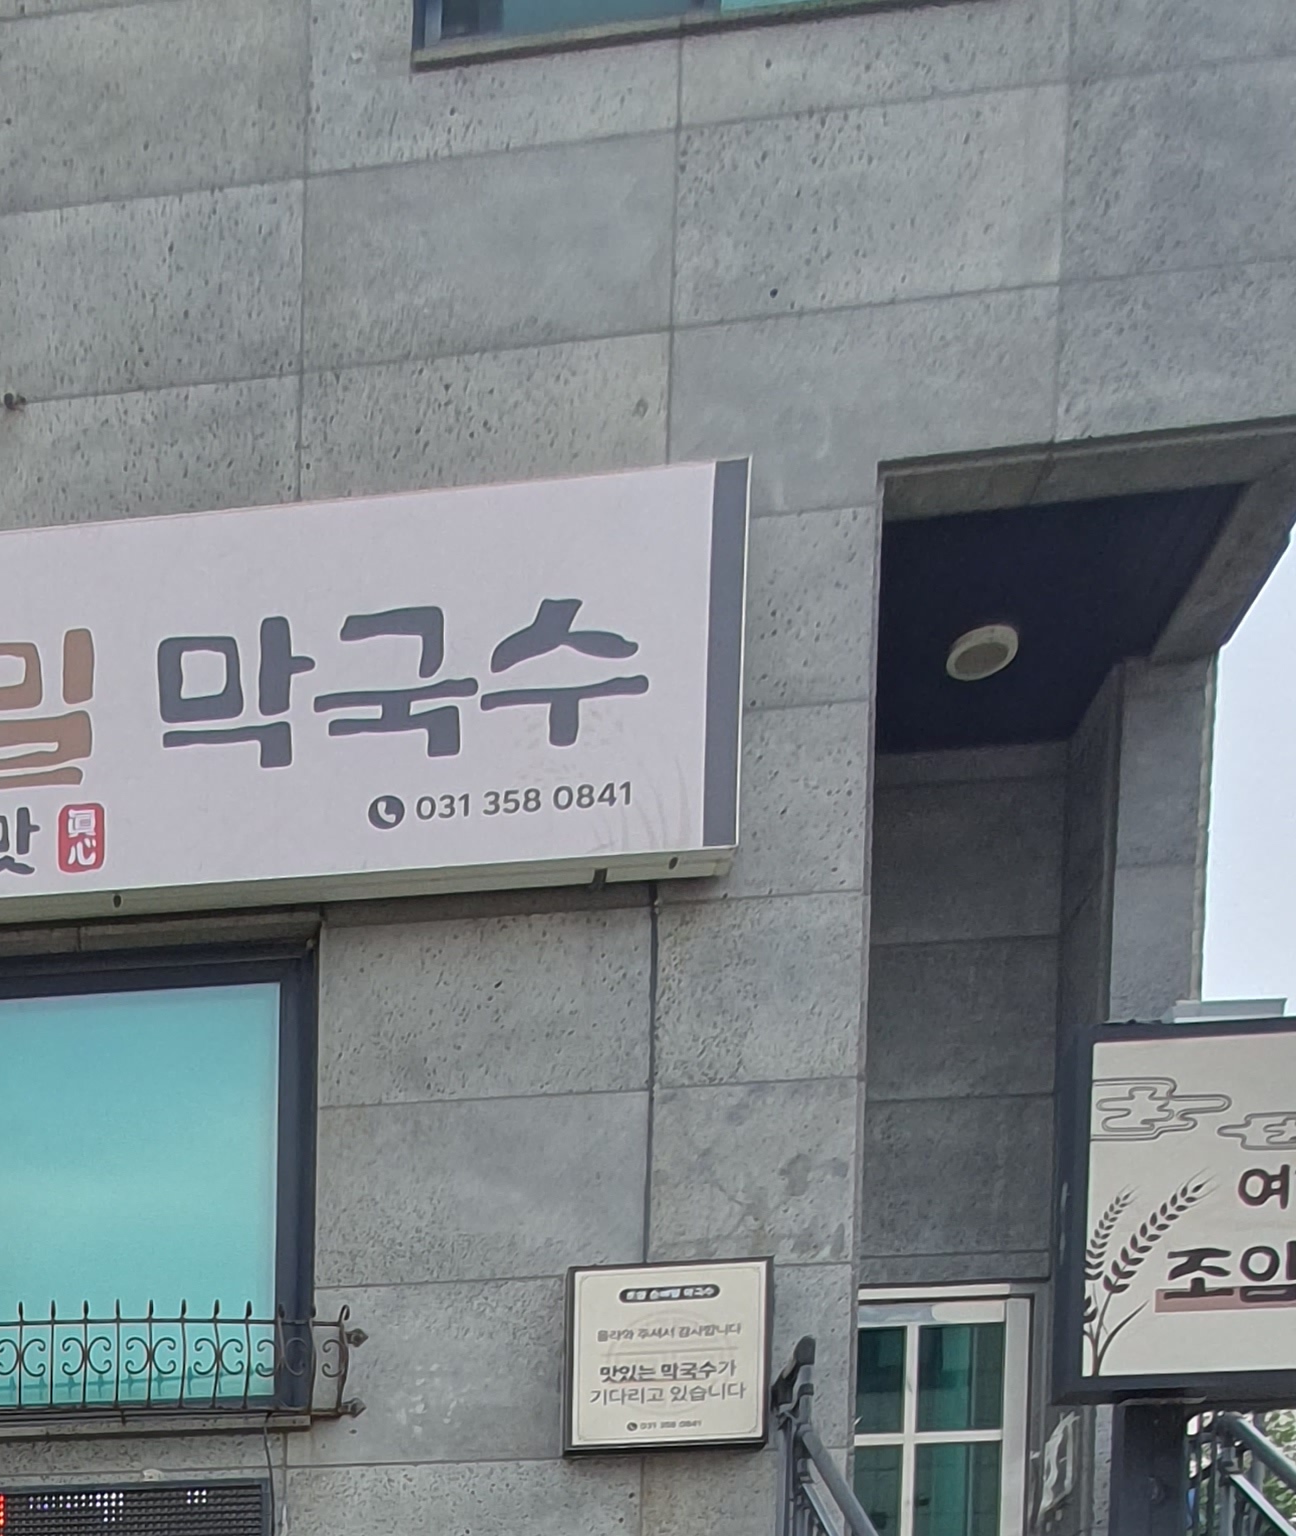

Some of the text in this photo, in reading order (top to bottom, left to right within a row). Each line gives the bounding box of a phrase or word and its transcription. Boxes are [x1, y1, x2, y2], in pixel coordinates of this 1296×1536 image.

[157, 598, 649, 769] 막국수
[415, 782, 633, 821] 031 358 0841
[600, 1360, 737, 1383] 맛있는 막국수가
[590, 1382, 747, 1406] 기다리고 있습니다
